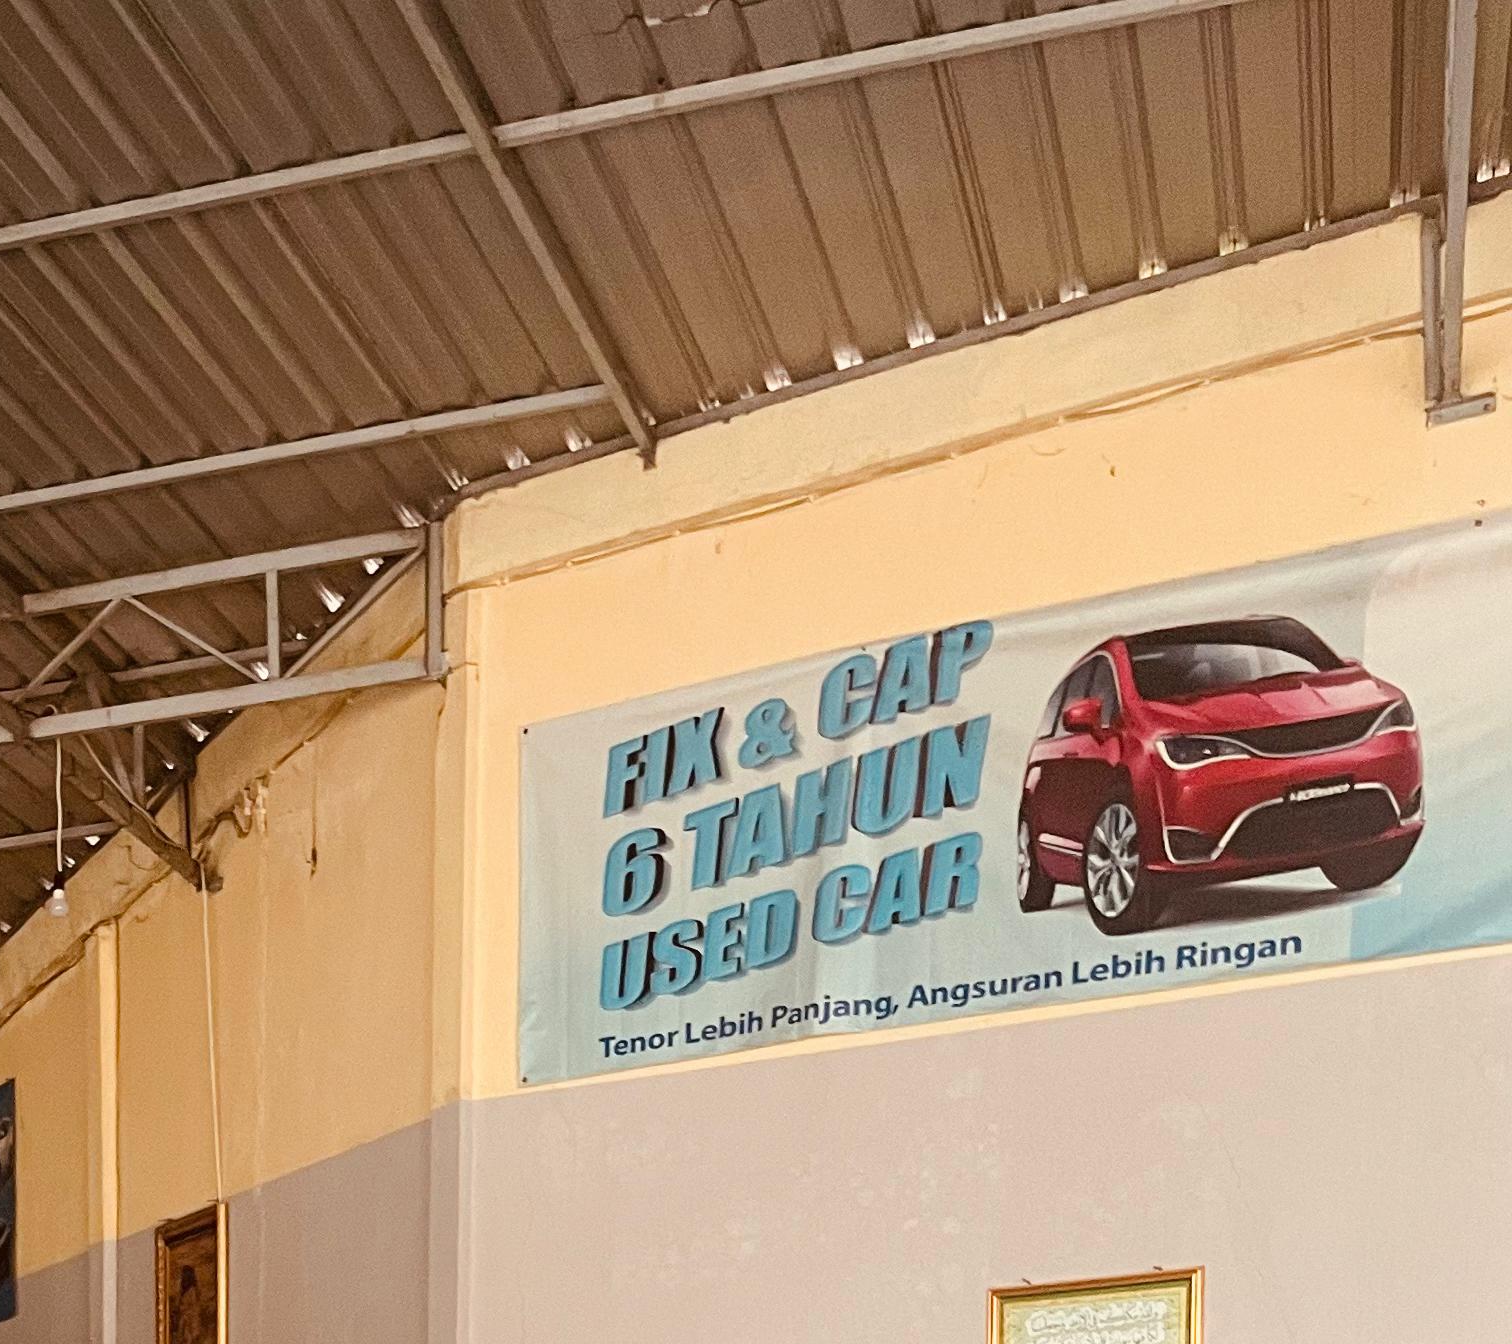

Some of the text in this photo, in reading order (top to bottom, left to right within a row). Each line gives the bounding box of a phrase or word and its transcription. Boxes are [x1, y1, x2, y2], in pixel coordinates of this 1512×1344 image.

[602, 619, 994, 818] FIX & CAP
[603, 713, 992, 917] 6 TAHUN
[599, 831, 983, 1011] USED CAR
[599, 934, 1303, 1058] Tenor Lebih Panjang, Angsuran Lebih Ringan
